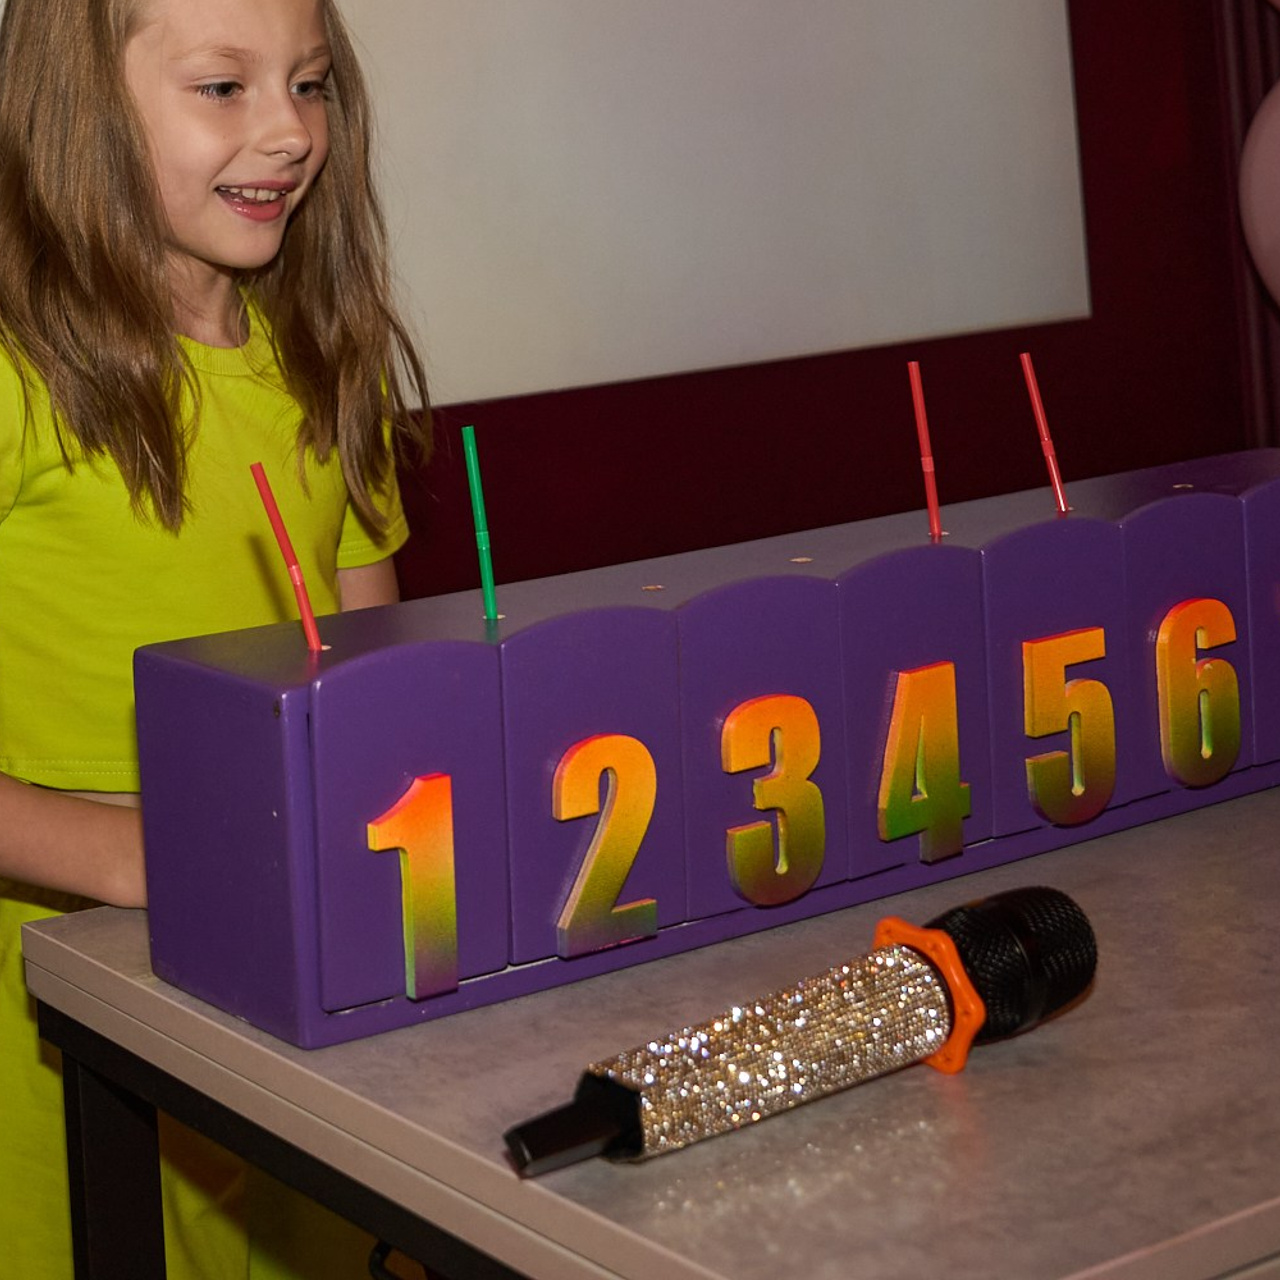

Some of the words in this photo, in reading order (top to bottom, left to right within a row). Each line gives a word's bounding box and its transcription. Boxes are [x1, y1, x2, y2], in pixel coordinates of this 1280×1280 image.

[367, 773, 459, 1001] 1
[552, 734, 657, 959] 2
[721, 693, 825, 907] 3
[878, 661, 971, 864] 4
[1022, 626, 1116, 828] 5
[1157, 598, 1240, 790] 6
